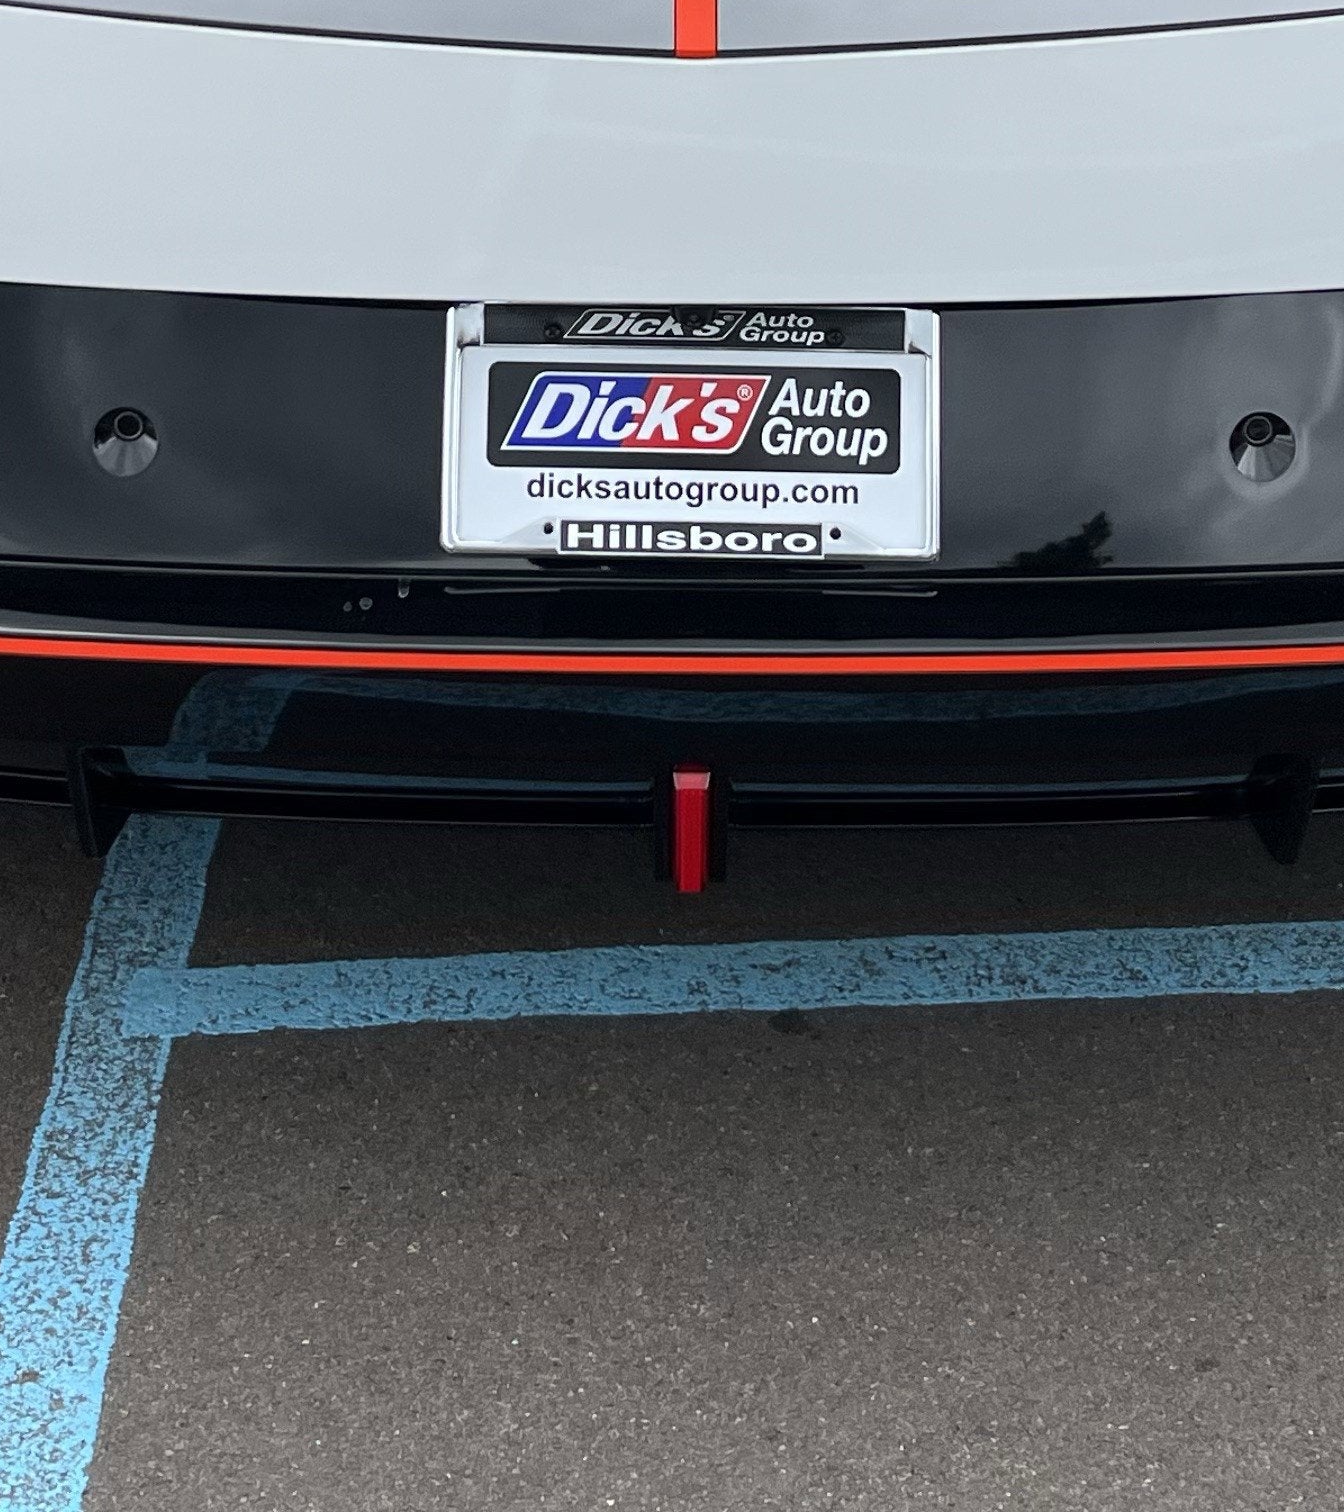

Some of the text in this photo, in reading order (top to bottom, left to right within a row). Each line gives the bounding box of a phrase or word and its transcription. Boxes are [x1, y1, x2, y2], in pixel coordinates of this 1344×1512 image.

[577, 313, 726, 337] Dicks
[739, 326, 826, 346] Group
[745, 311, 815, 329] Auto
[520, 380, 740, 443] Dick's
[768, 378, 871, 418] Auto
[761, 418, 888, 465] Group
[527, 473, 859, 508] dicksautogroup.com
[567, 524, 818, 553] Hillsboro
